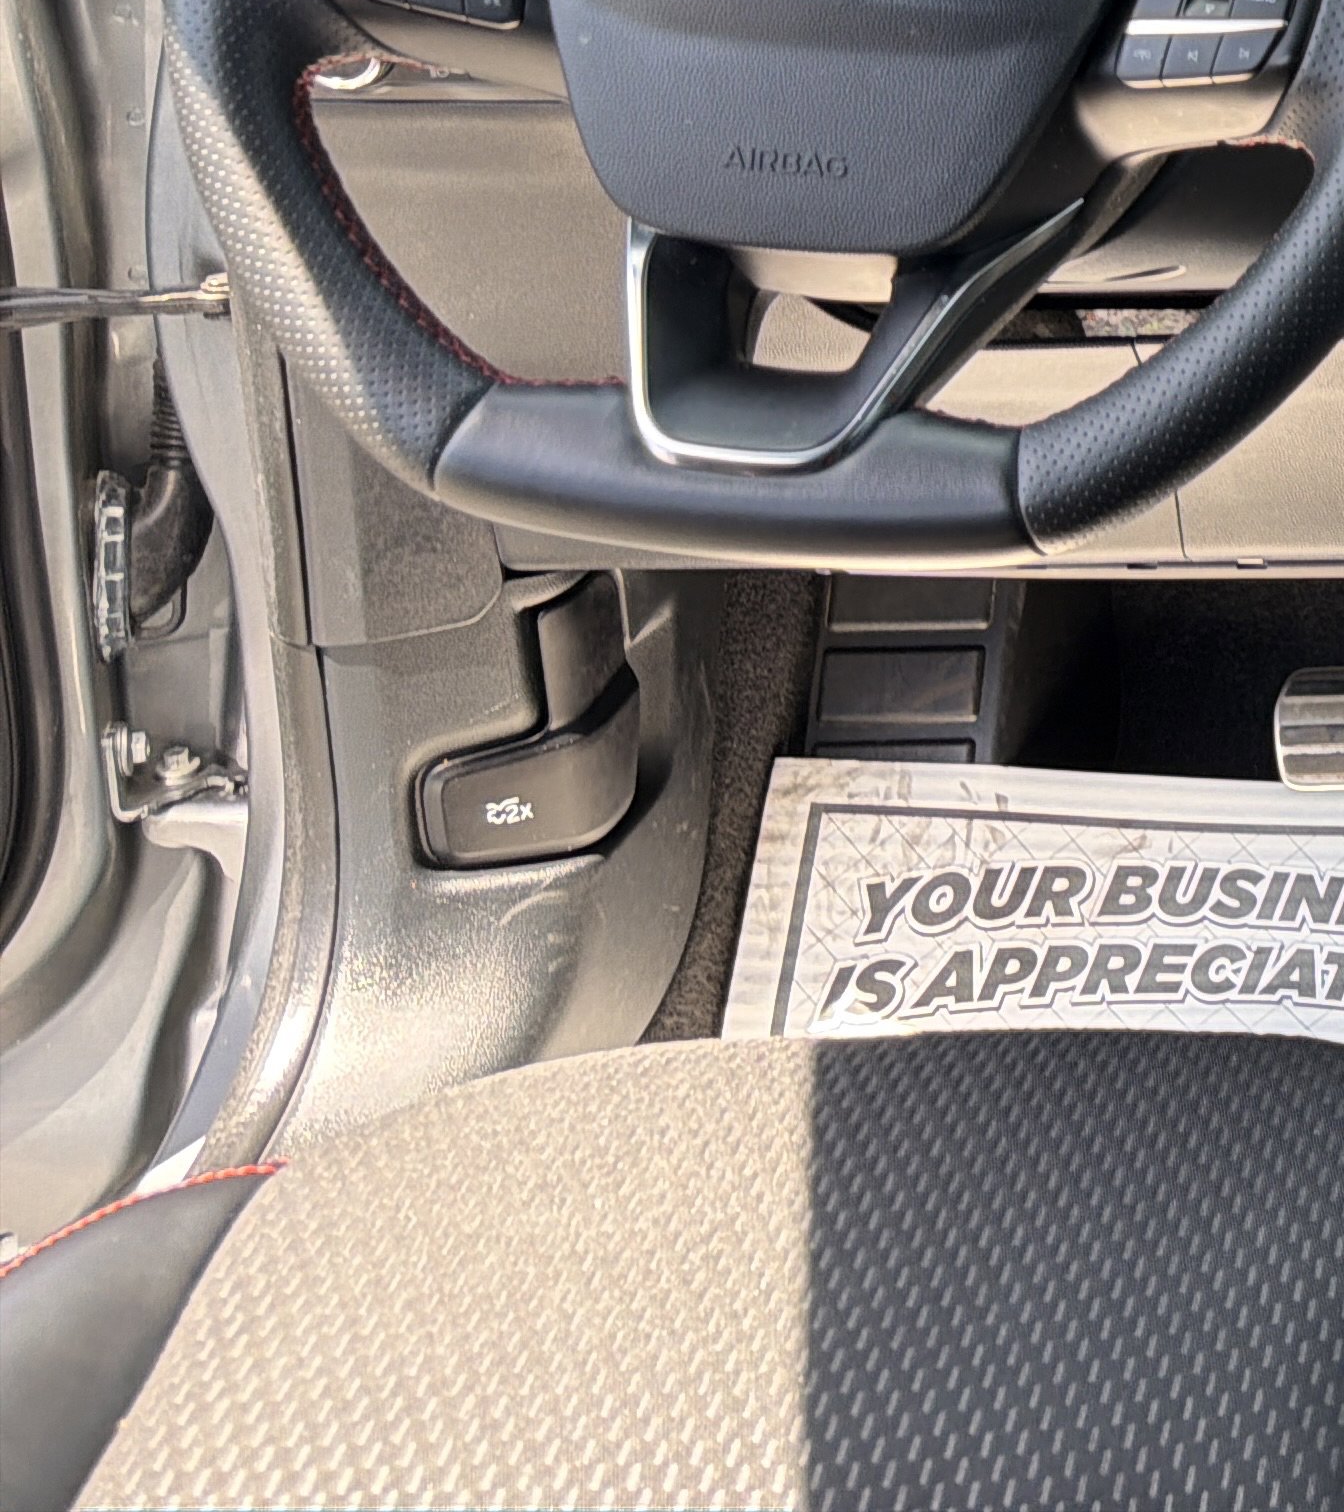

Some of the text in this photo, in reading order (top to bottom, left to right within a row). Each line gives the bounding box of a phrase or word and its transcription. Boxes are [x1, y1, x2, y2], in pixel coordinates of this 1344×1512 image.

[724, 145, 849, 179] AIRBAG
[858, 862, 1095, 942] YOUR
[818, 957, 914, 1024] IS
